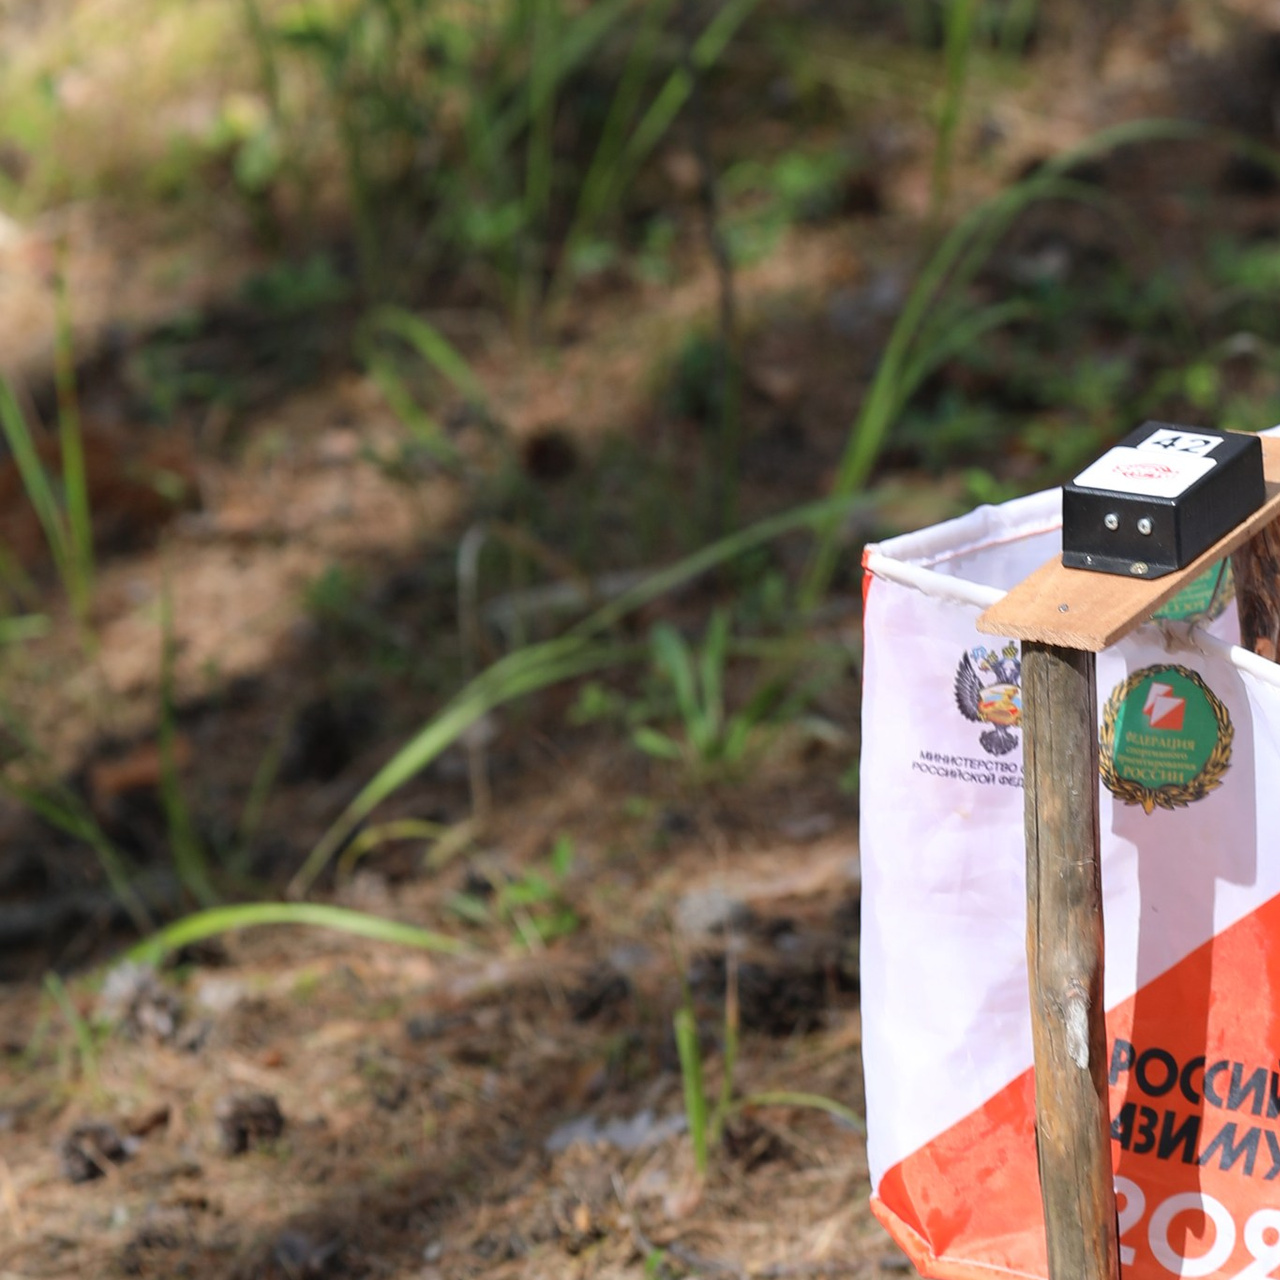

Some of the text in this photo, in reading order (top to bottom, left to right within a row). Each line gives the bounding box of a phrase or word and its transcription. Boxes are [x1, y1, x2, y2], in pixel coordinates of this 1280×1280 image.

[1151, 434, 1212, 454] 42
[919, 750, 1018, 774] МИНИСТЕРСТВО
[911, 761, 996, 786] РОССИЙСКОЙ
[1122, 765, 1185, 784] РОССИИ
